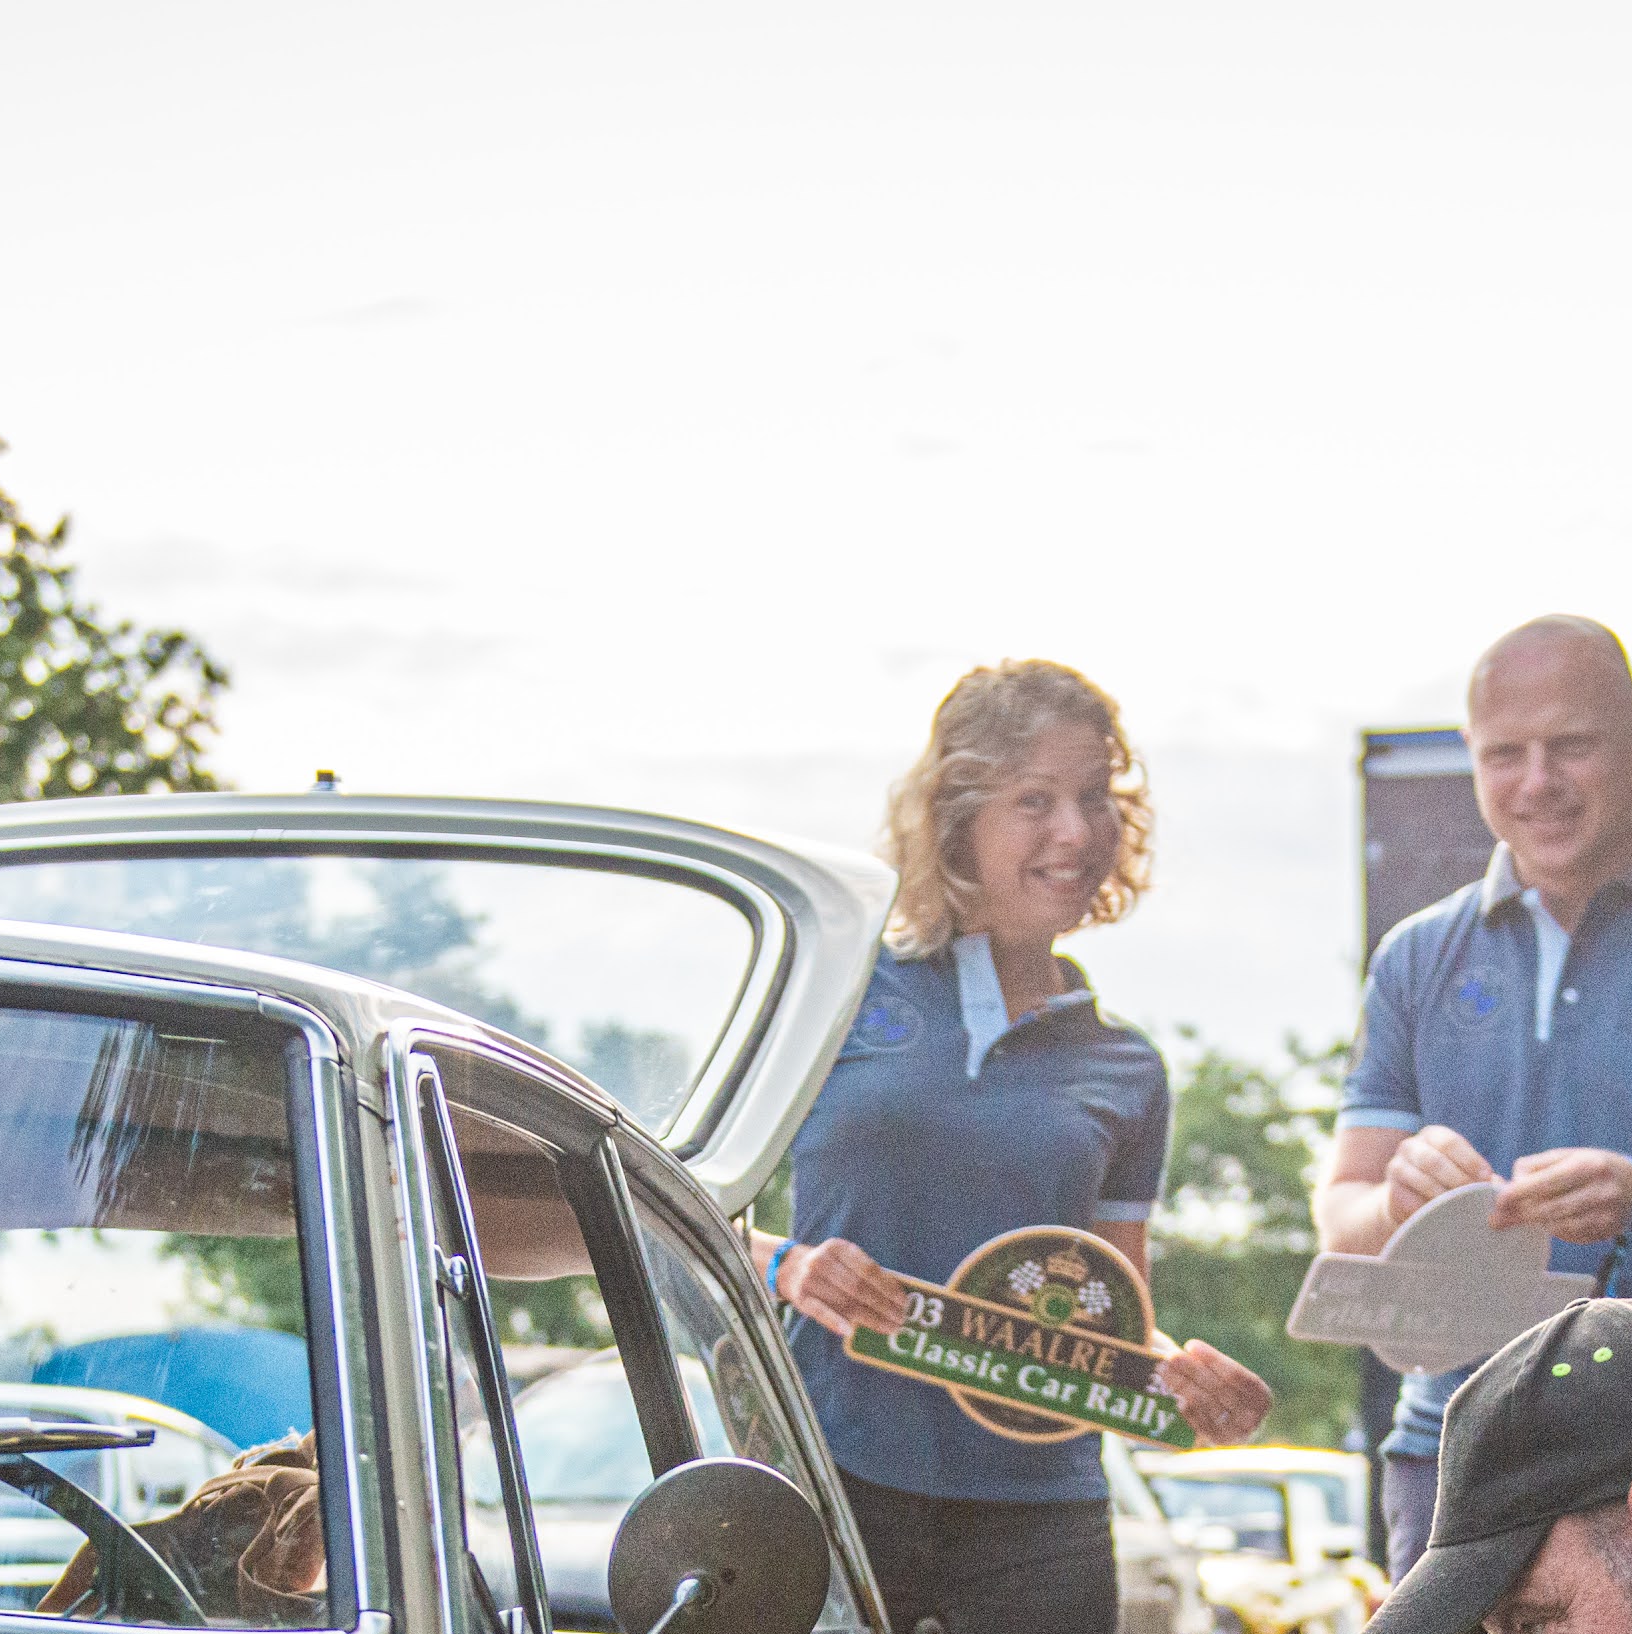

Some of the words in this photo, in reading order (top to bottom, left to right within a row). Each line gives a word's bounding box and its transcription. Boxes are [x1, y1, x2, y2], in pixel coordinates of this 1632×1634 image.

[888, 1326, 1009, 1384] Classic
[1017, 1365, 1079, 1402] Car
[1085, 1382, 1175, 1437] Rally
[961, 1307, 1117, 1381] WAALRE
